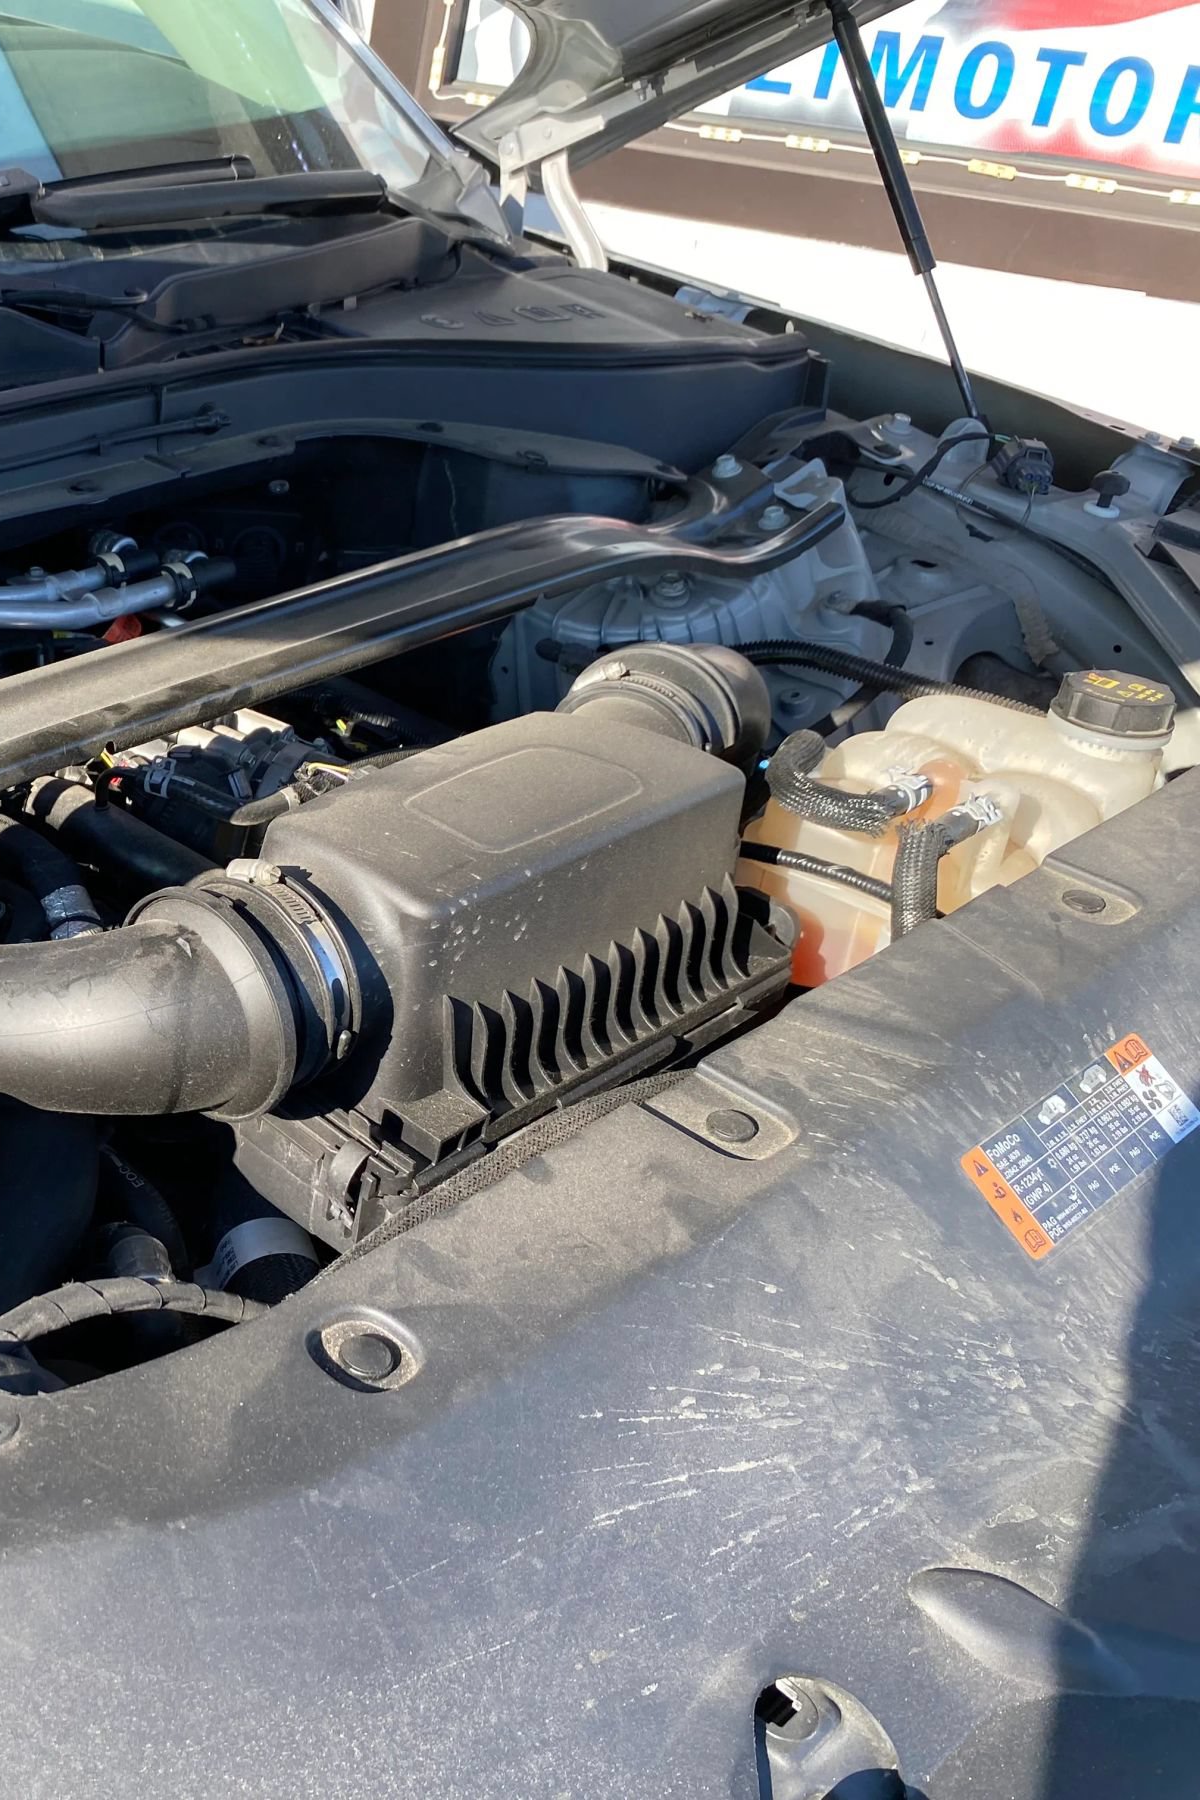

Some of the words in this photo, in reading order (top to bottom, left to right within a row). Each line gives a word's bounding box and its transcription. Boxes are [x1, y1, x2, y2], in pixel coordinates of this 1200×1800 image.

[1147, 1129, 1161, 1142] POE
[984, 1129, 1021, 1162] FoMoCo
[1128, 1145, 1141, 1159] PAG
[995, 1157, 1010, 1171] SAE
[1107, 1161, 1121, 1175] POE
[1012, 1166, 1046, 1197] R-1234yf
[1086, 1178, 1100, 1192] PAG
[1022, 1185, 1047, 1210] (GWP
[1039, 1180, 1054, 1196] 4)
[1040, 1214, 1058, 1232] PAG
[1047, 1223, 1065, 1240] POE
